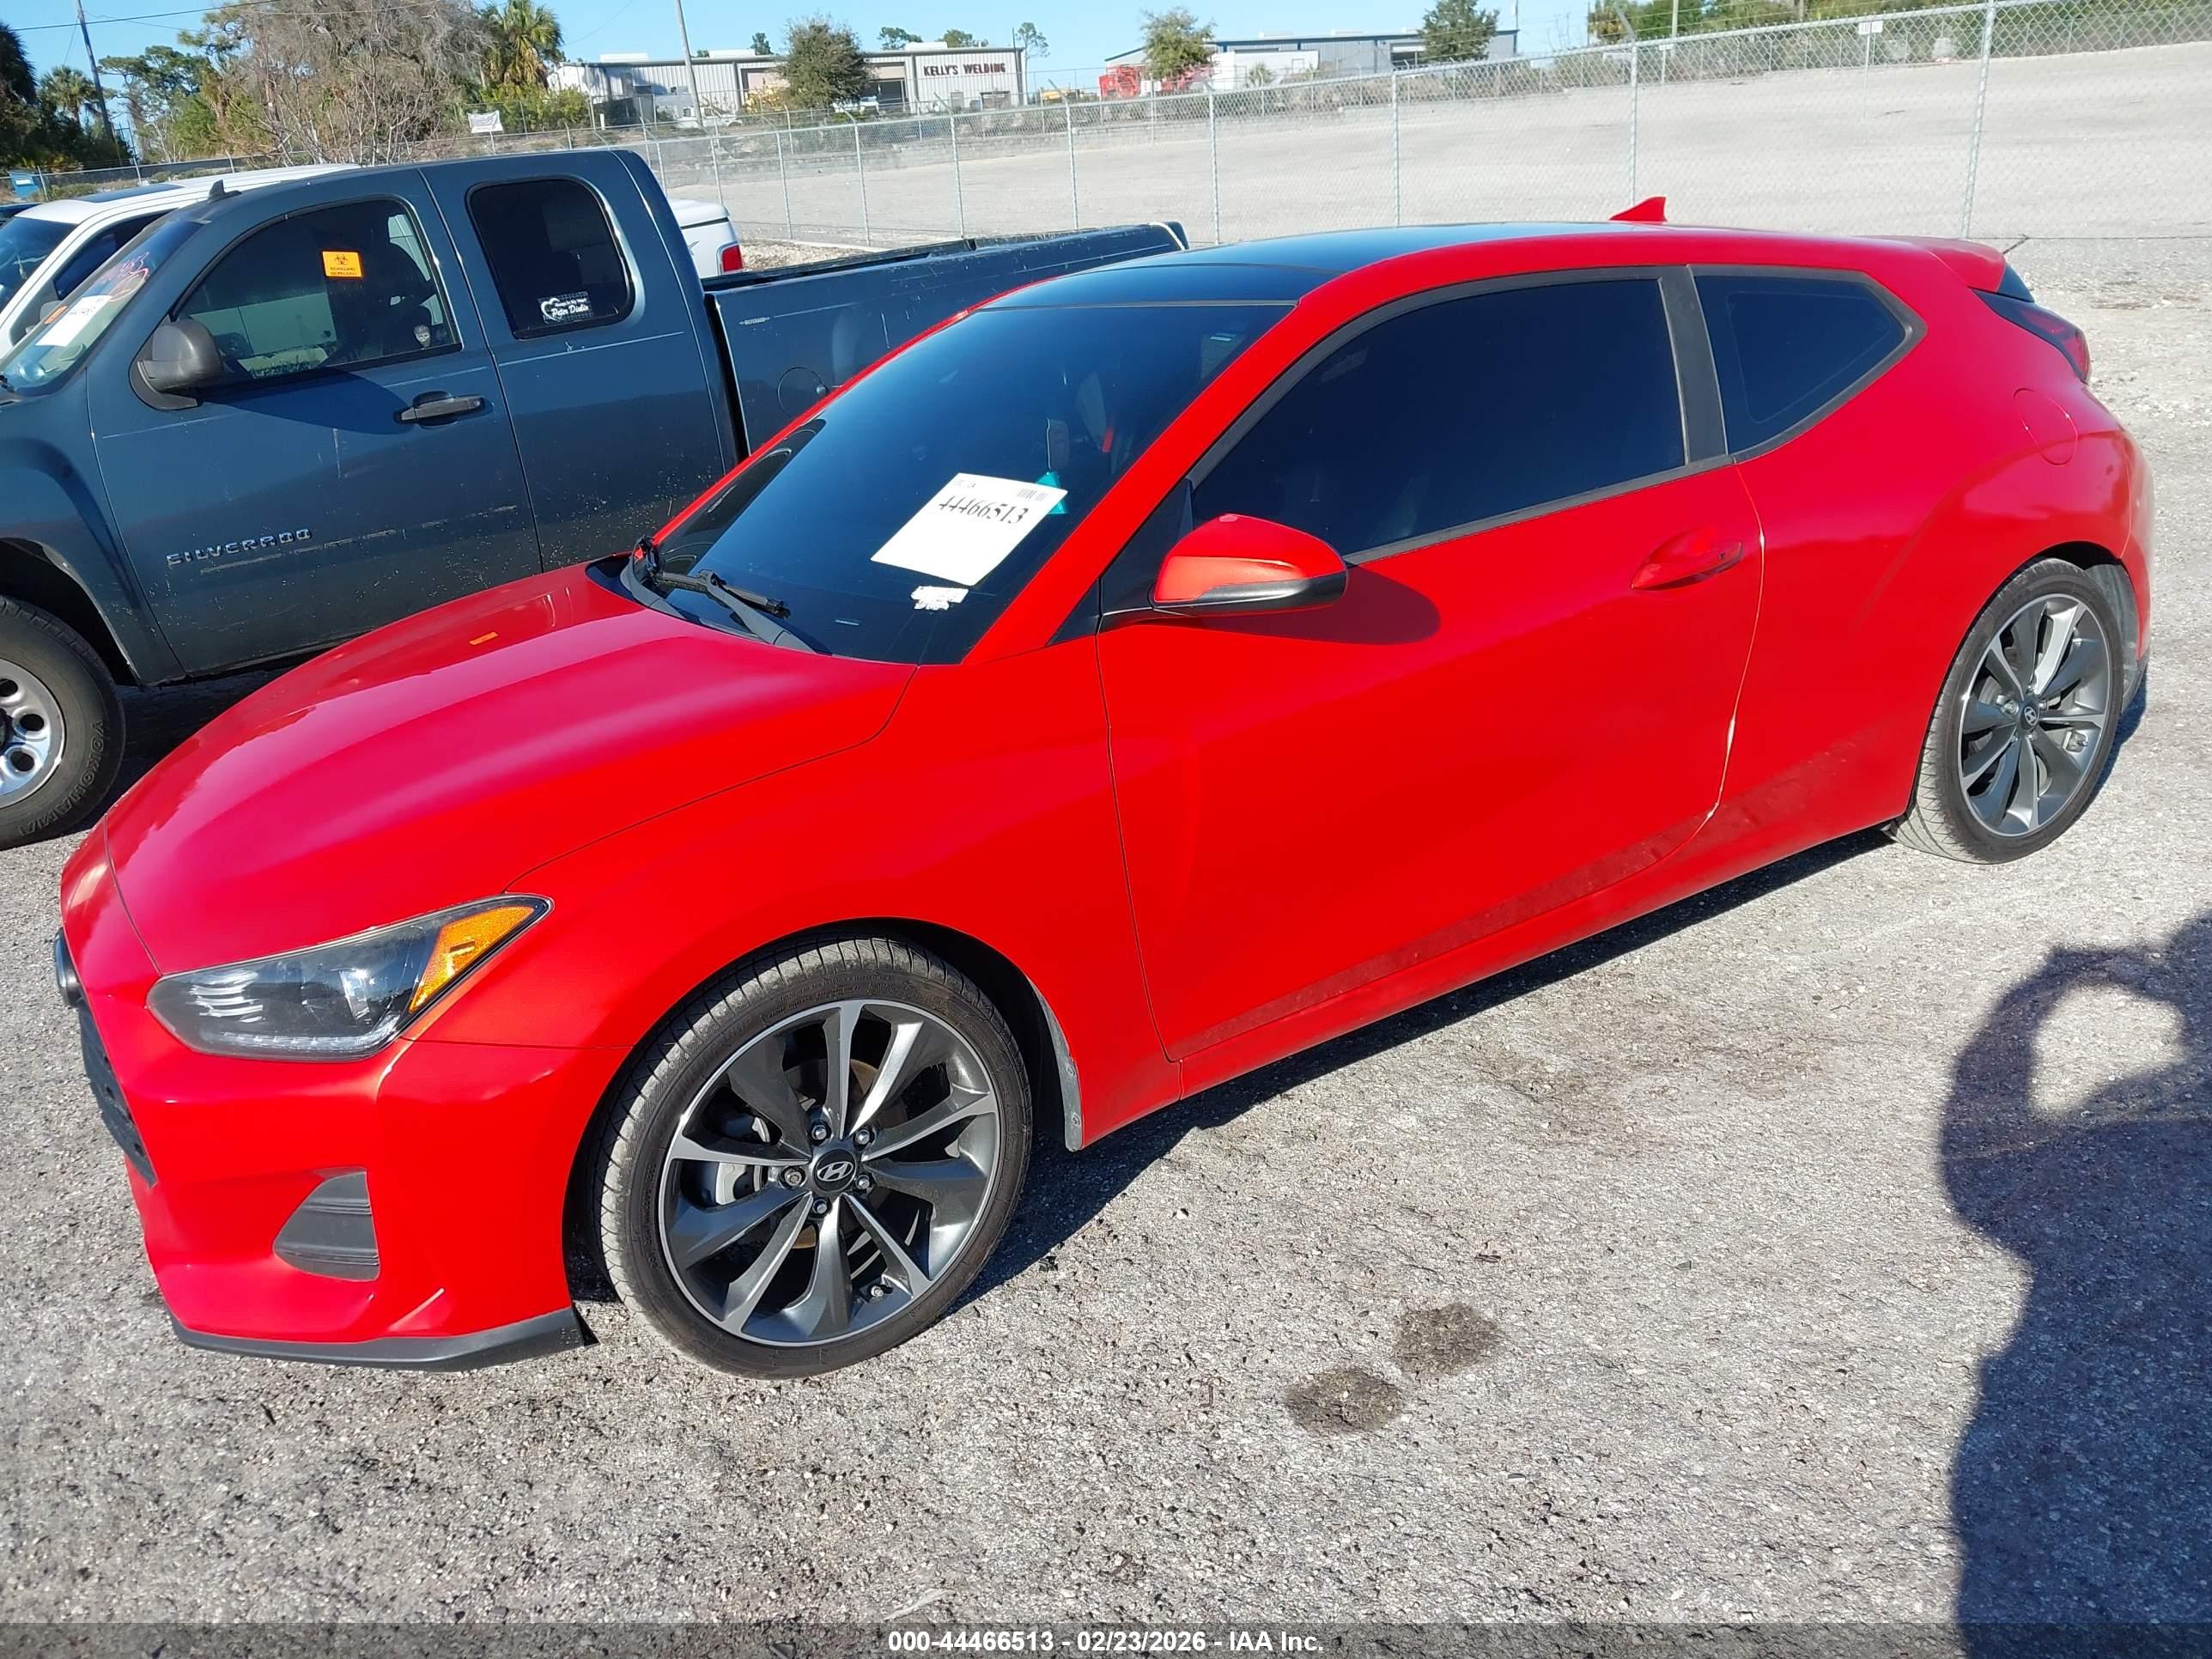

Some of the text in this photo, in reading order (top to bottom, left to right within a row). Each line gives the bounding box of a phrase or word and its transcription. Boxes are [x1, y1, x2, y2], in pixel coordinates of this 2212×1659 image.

[923, 63, 1006, 76] KELLY'S WELDING
[939, 495, 1029, 524] 44466513
[166, 528, 311, 565] SILVERADO
[19, 720, 106, 837] YOKOHAMA
